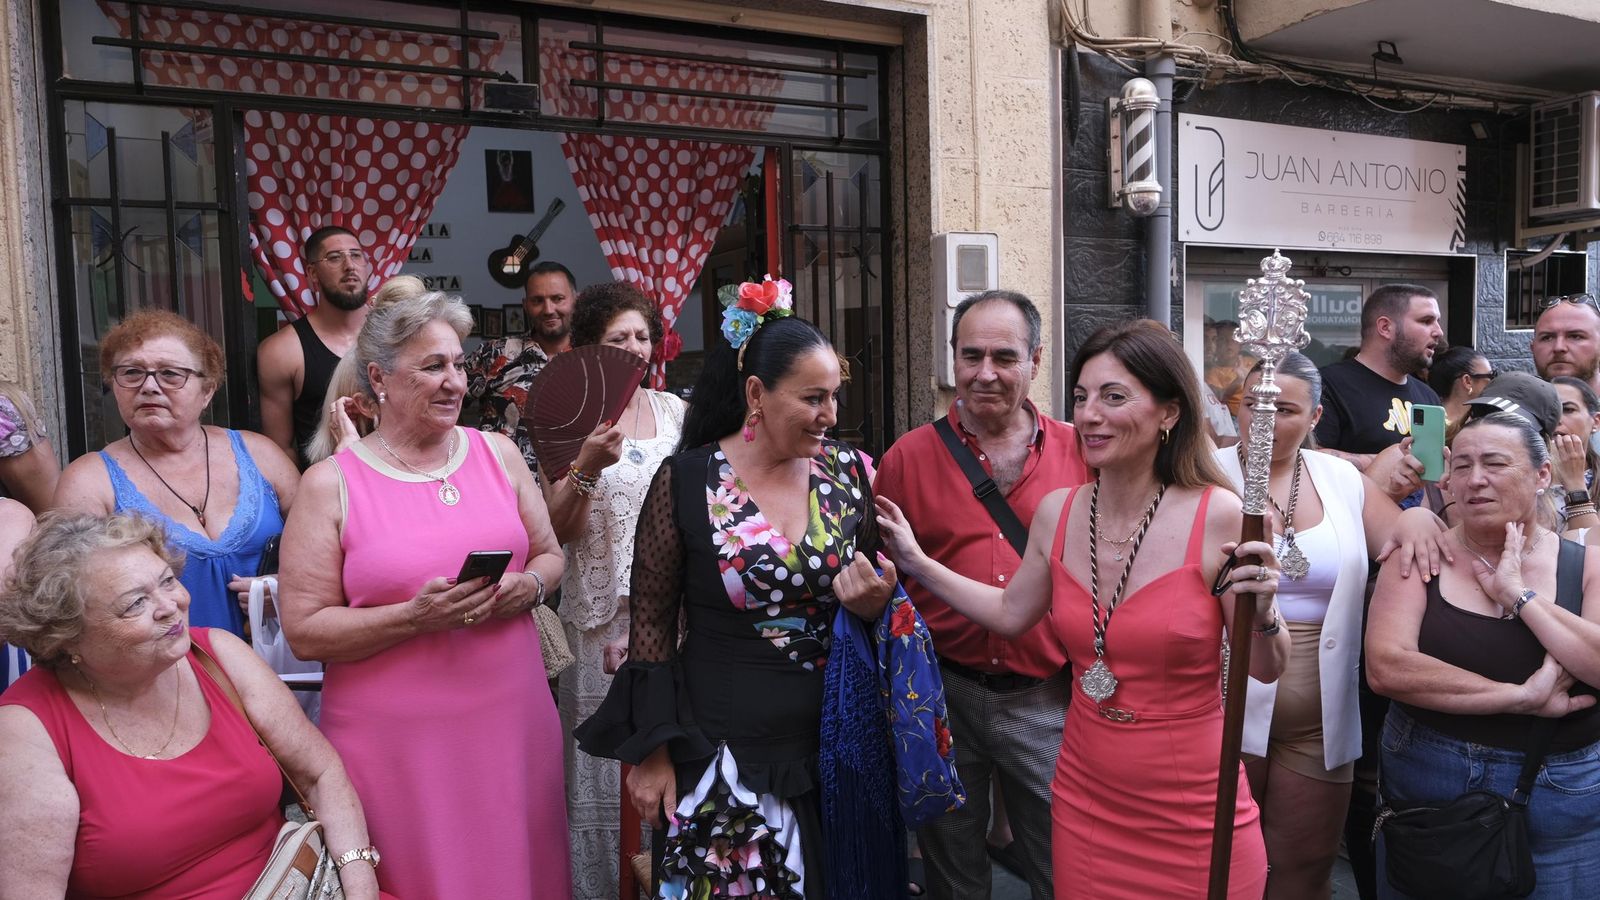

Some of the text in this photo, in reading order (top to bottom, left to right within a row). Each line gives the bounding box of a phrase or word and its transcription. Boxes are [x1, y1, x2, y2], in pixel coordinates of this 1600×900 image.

[1245, 151, 1447, 194] JUAN ANTONIO
[420, 224, 449, 236] IA
